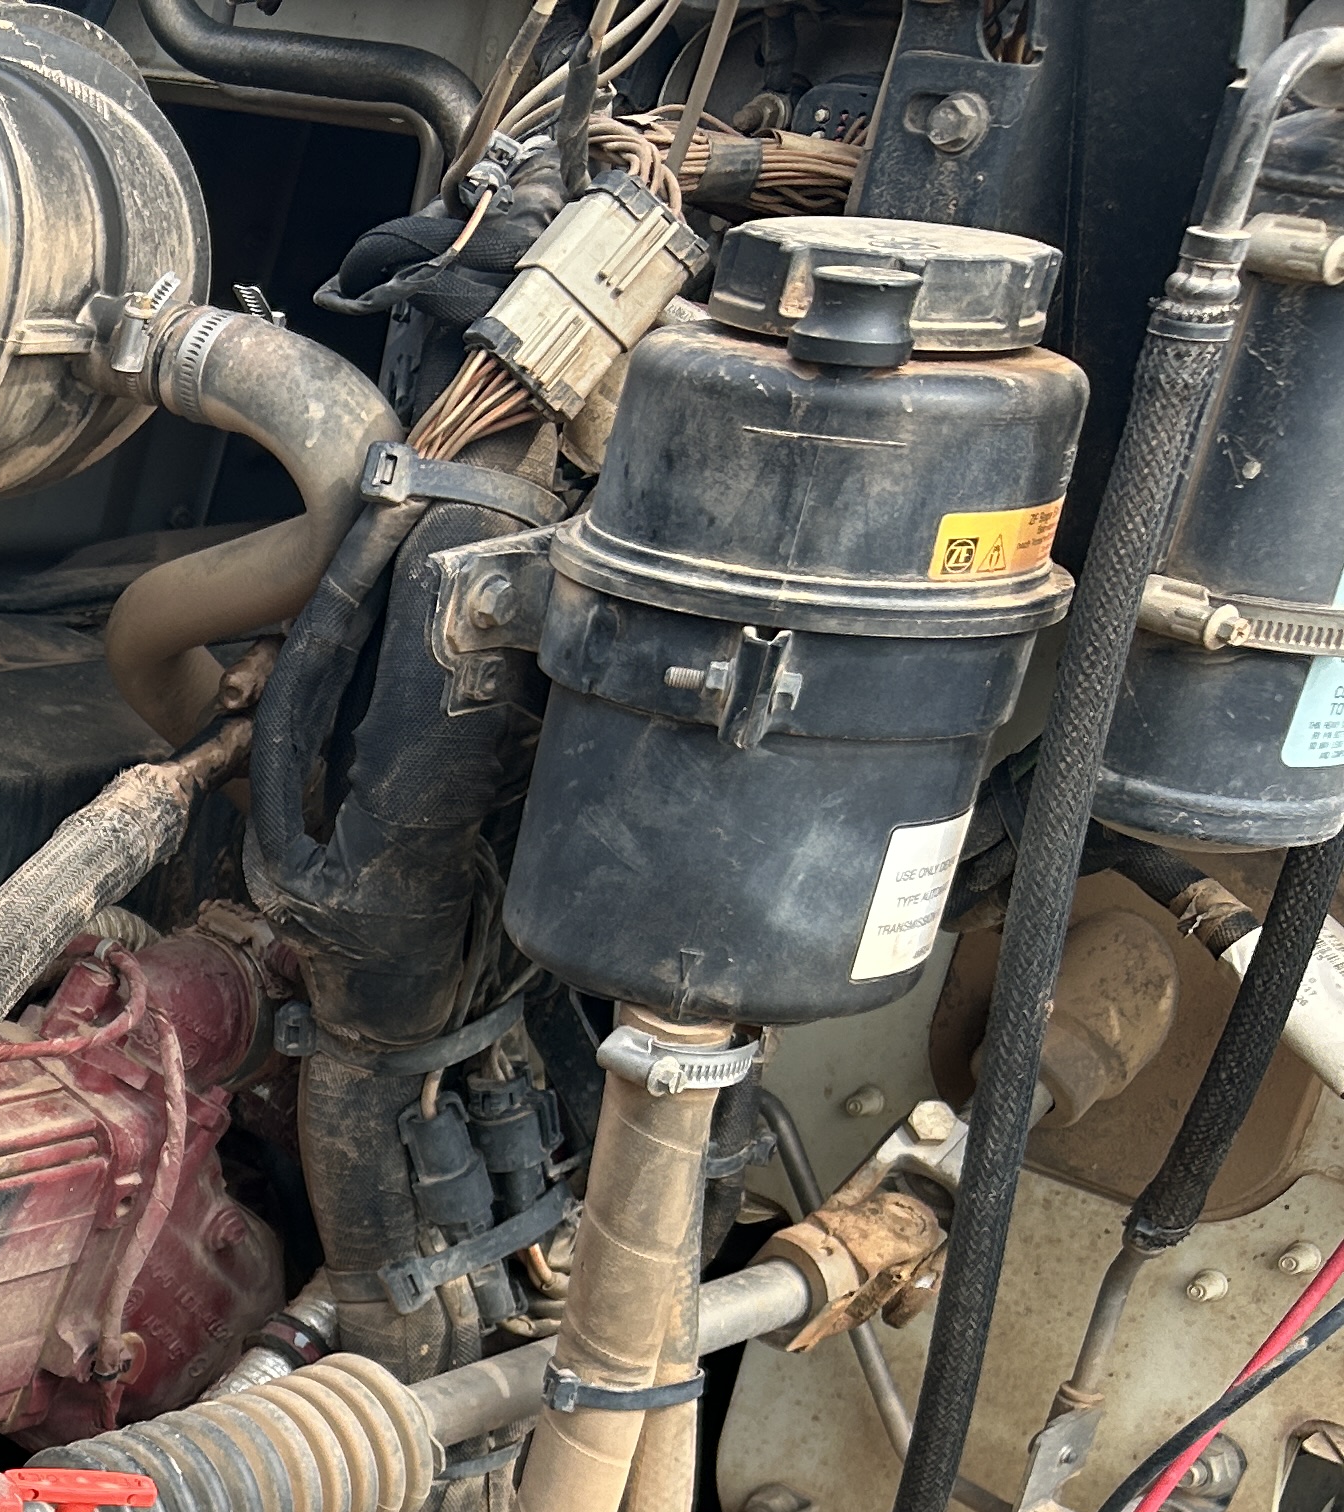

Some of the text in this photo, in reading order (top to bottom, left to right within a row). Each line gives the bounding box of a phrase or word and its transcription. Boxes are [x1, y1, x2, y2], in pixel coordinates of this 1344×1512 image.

[945, 542, 975, 570] ZF
[895, 868, 917, 883] USE
[897, 892, 921, 908] TYPE
